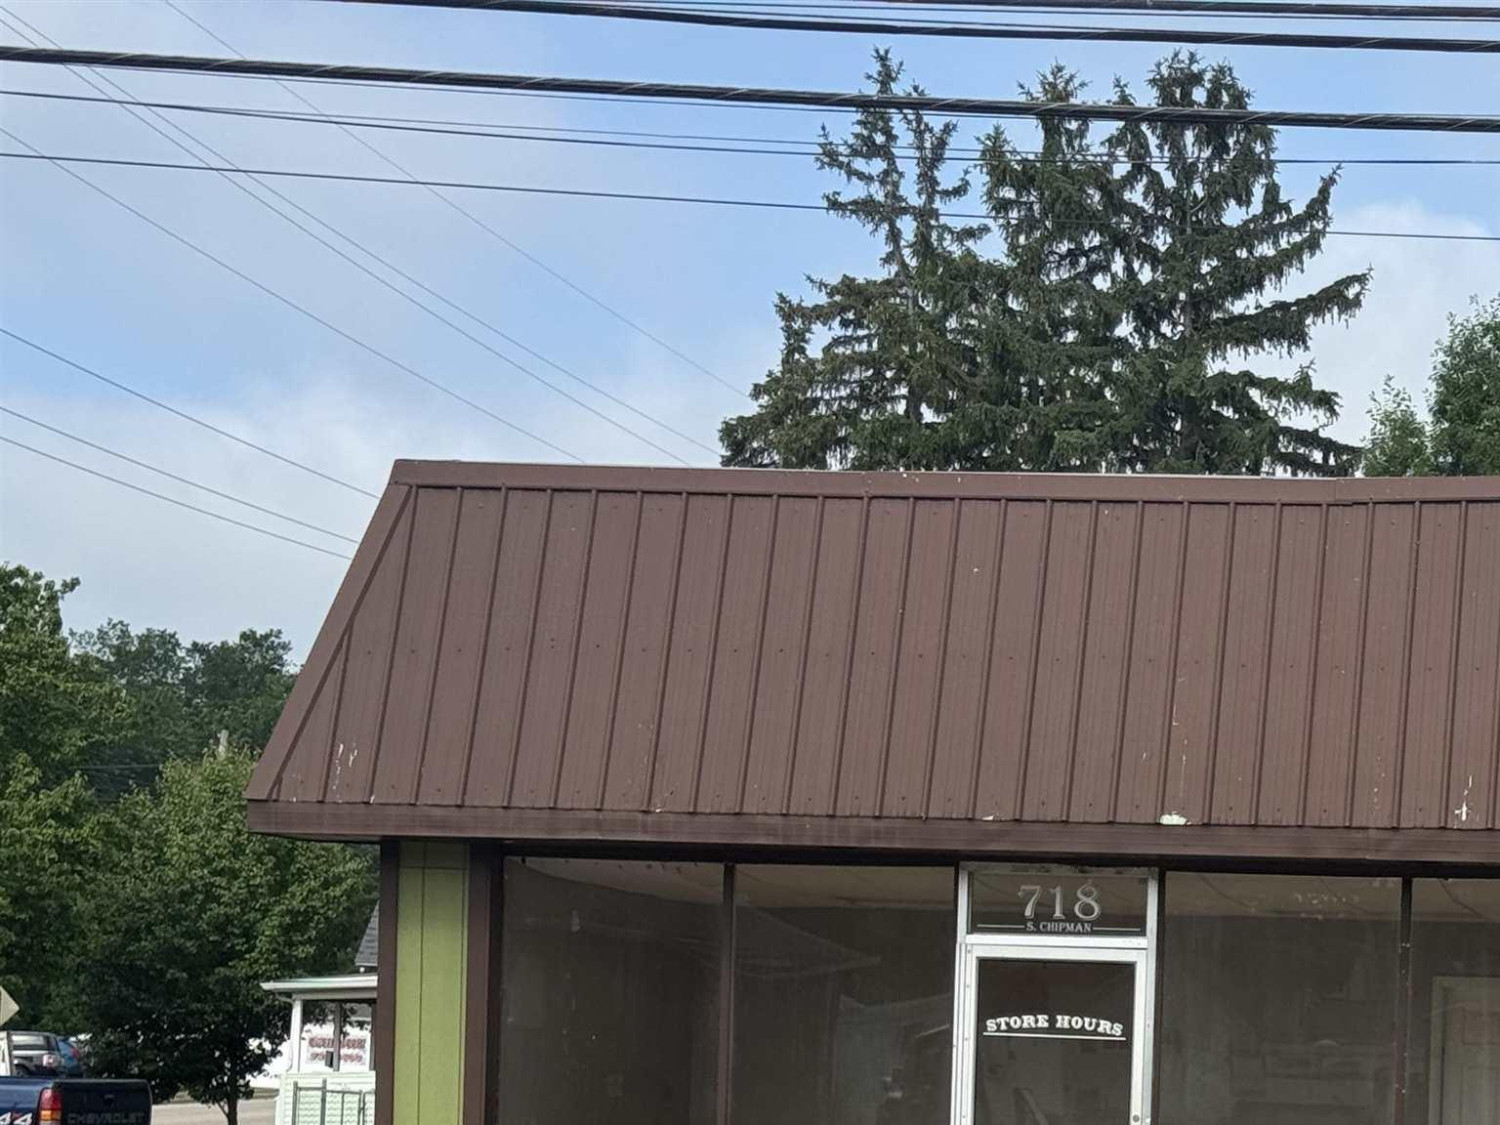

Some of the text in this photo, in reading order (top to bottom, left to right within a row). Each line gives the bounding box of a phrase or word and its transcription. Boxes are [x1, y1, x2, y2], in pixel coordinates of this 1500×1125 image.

[1017, 881, 1101, 922] 718
[1026, 921, 1092, 933] S. CHIPMAN
[985, 1014, 1124, 1037] STORE HOURS
[67, 1112, 145, 1125] CHEVROLET
